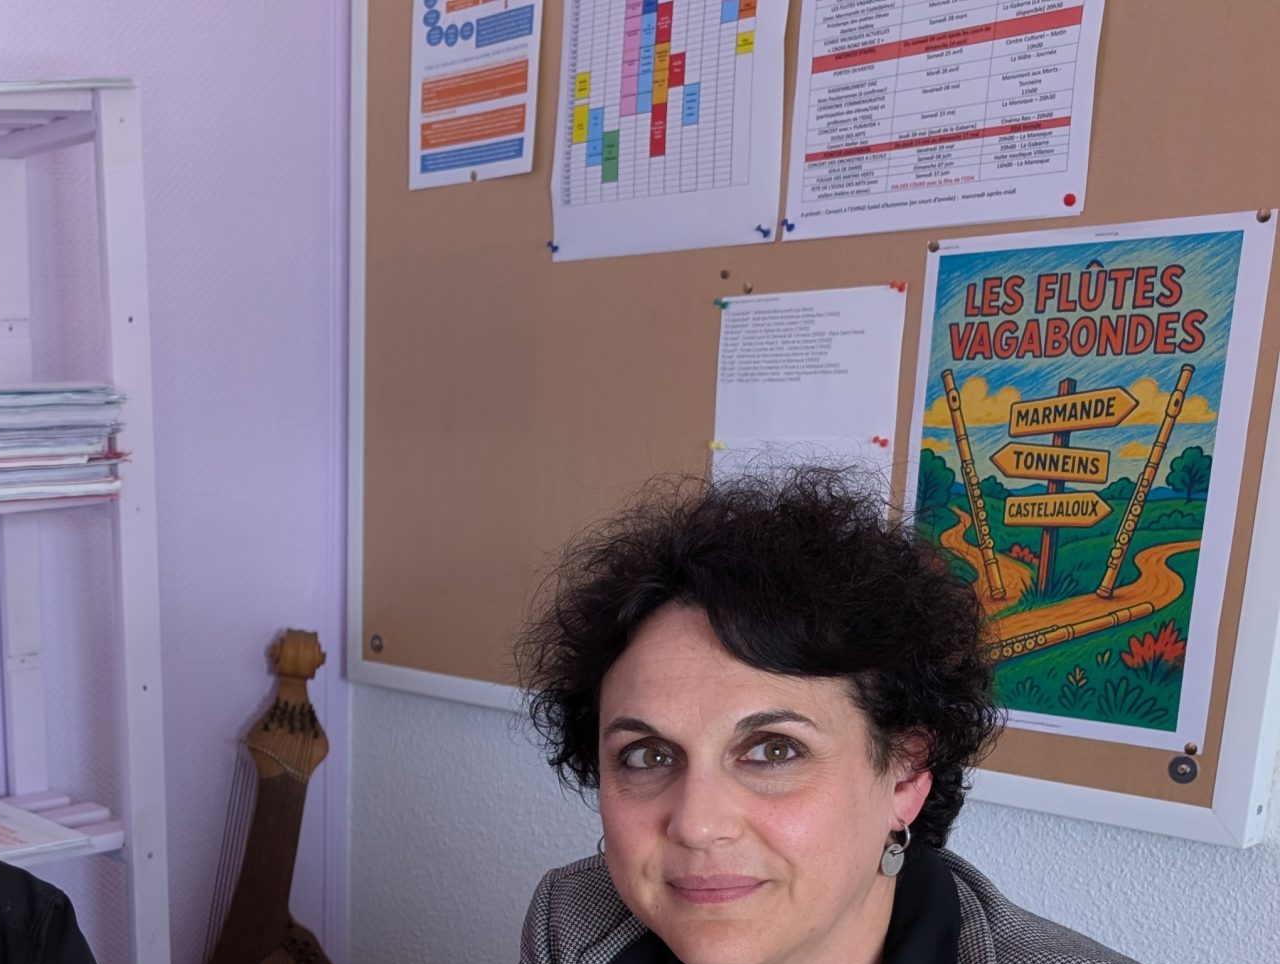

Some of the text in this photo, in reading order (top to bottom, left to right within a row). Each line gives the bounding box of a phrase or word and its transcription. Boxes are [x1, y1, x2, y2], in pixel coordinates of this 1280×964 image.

[1027, 42, 1043, 50] 10h00
[1002, 72, 1030, 80] Monument
[987, 188, 1016, 197] après-midi
[965, 259, 1185, 317] LES FLÛTES
[950, 309, 1208, 361] VAGABONDES
[1016, 397, 1116, 427] MARMANDE
[1014, 451, 1099, 474] TONNEINS
[1008, 500, 1099, 518] CASTELJALOUX
